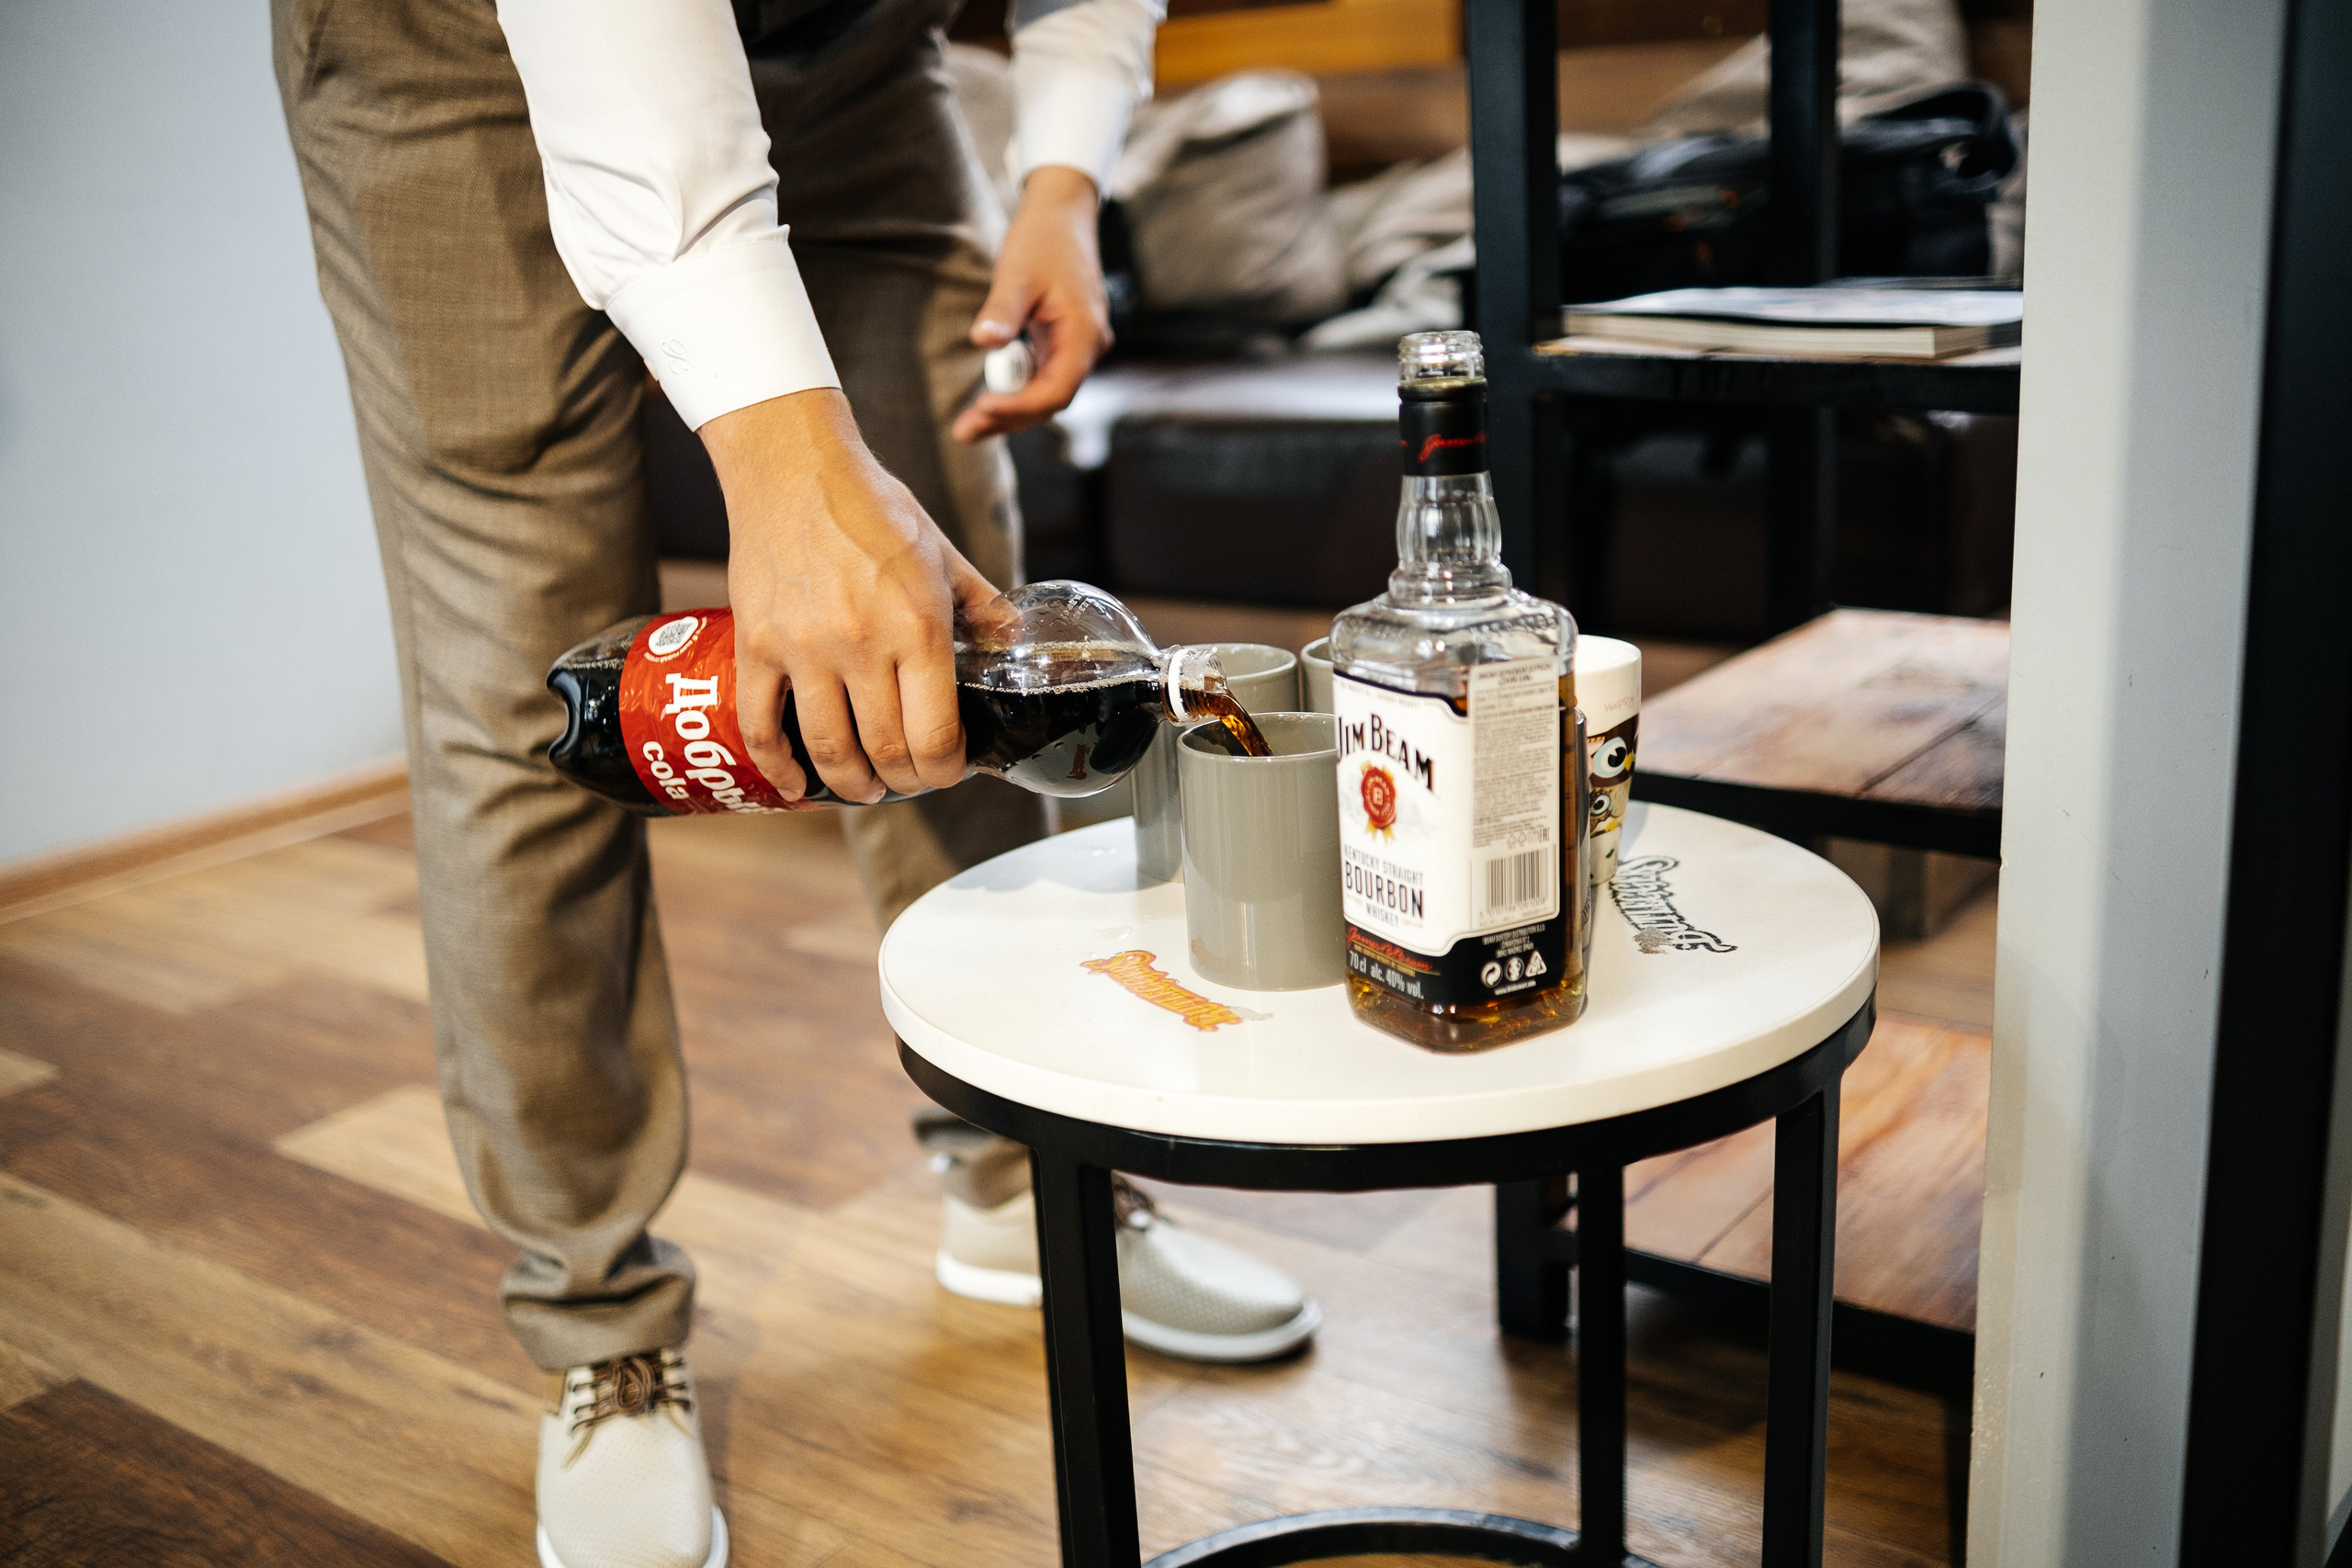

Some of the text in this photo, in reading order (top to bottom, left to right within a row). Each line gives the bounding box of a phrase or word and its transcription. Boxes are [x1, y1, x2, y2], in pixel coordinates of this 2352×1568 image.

[643, 740, 690, 800] cola
[1338, 716, 1365, 762] JIM
[1371, 713, 1434, 793] BEAM
[1344, 843, 1423, 886] KENTUCKY STRAIGHT
[1345, 860, 1423, 919] BOURBON
[1365, 902, 1399, 928] WHISKEY
[1349, 950, 1359, 970] 70
[1359, 957, 1367, 974] cl
[1370, 963, 1385, 983] alc.
[1385, 968, 1405, 992] 40%
[1406, 981, 1424, 999] vol.
